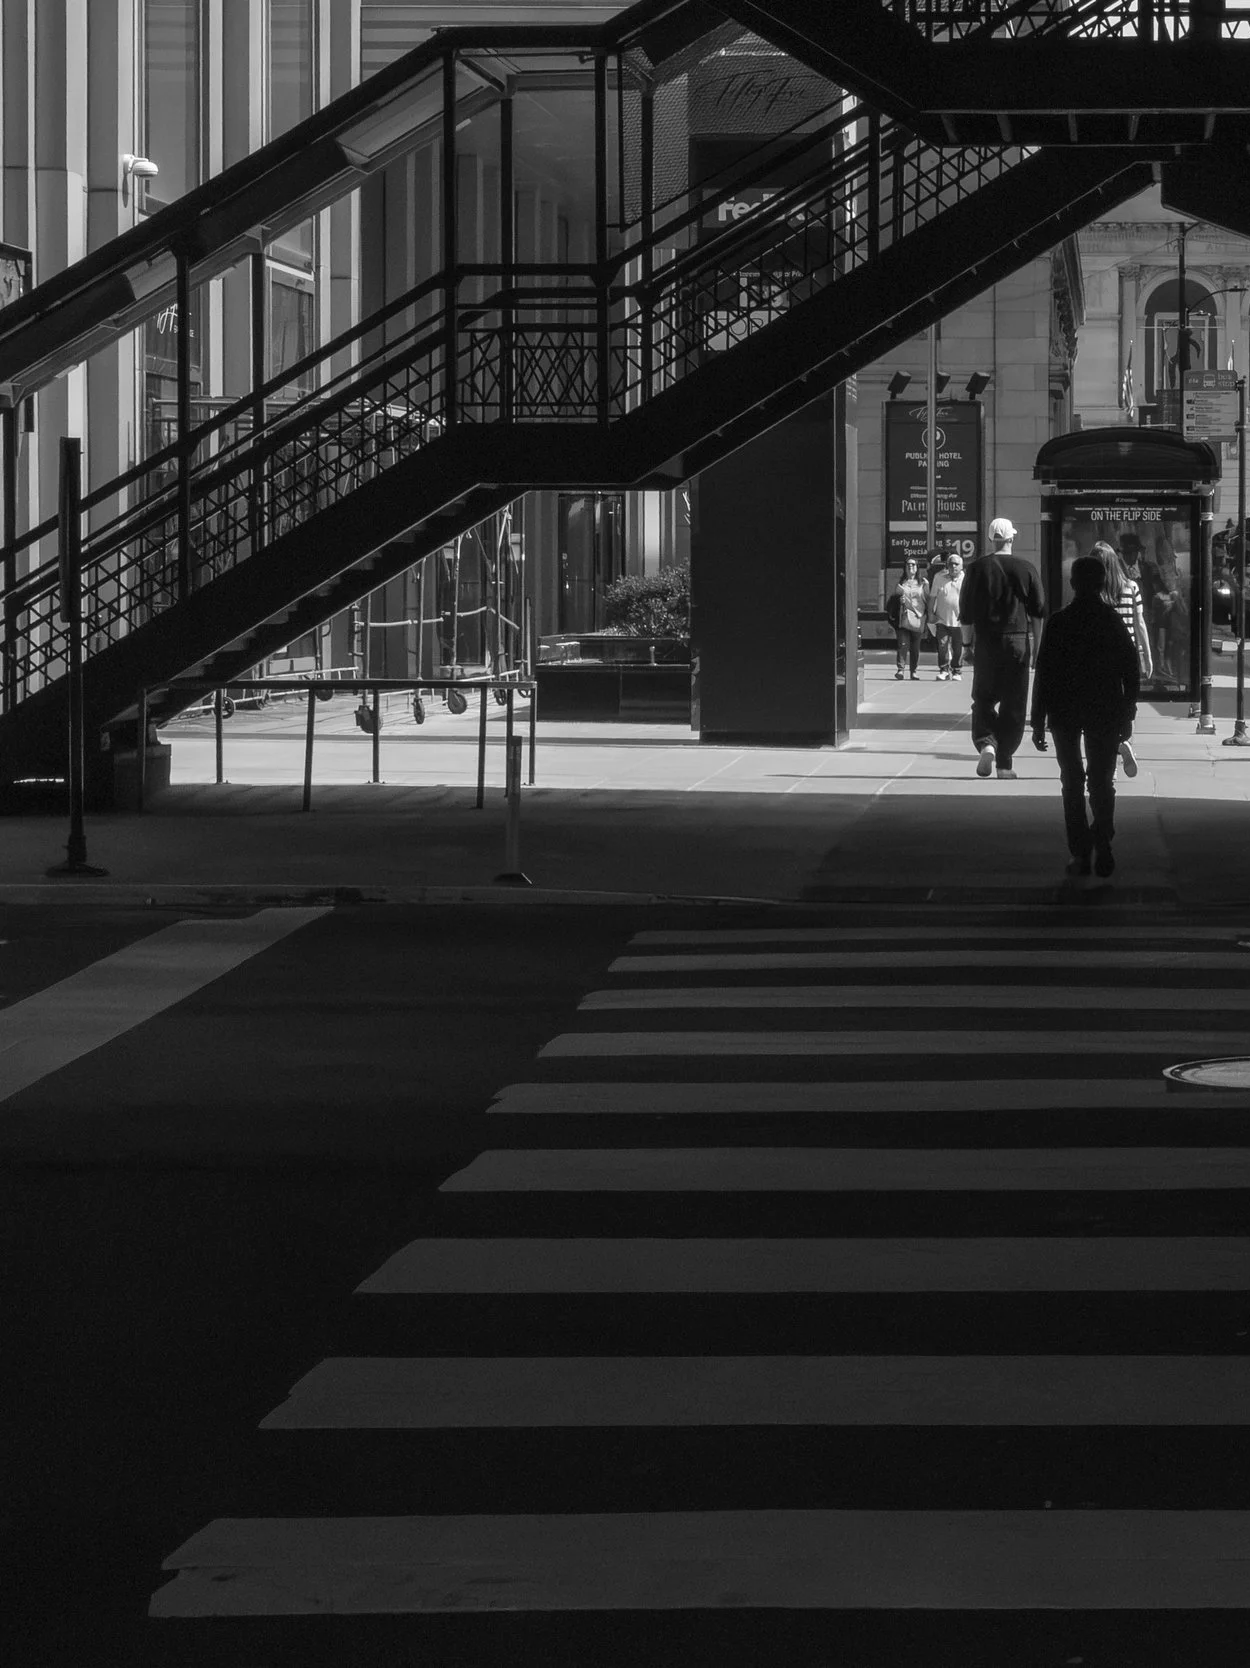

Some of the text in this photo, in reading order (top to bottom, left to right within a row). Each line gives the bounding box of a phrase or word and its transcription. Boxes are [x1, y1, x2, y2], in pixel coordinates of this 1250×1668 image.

[937, 499, 967, 513] HOUSE
[1090, 510, 1162, 521] ON THE FLIP SIDE
[891, 538, 911, 547] Early
[904, 548, 928, 556] Specia
